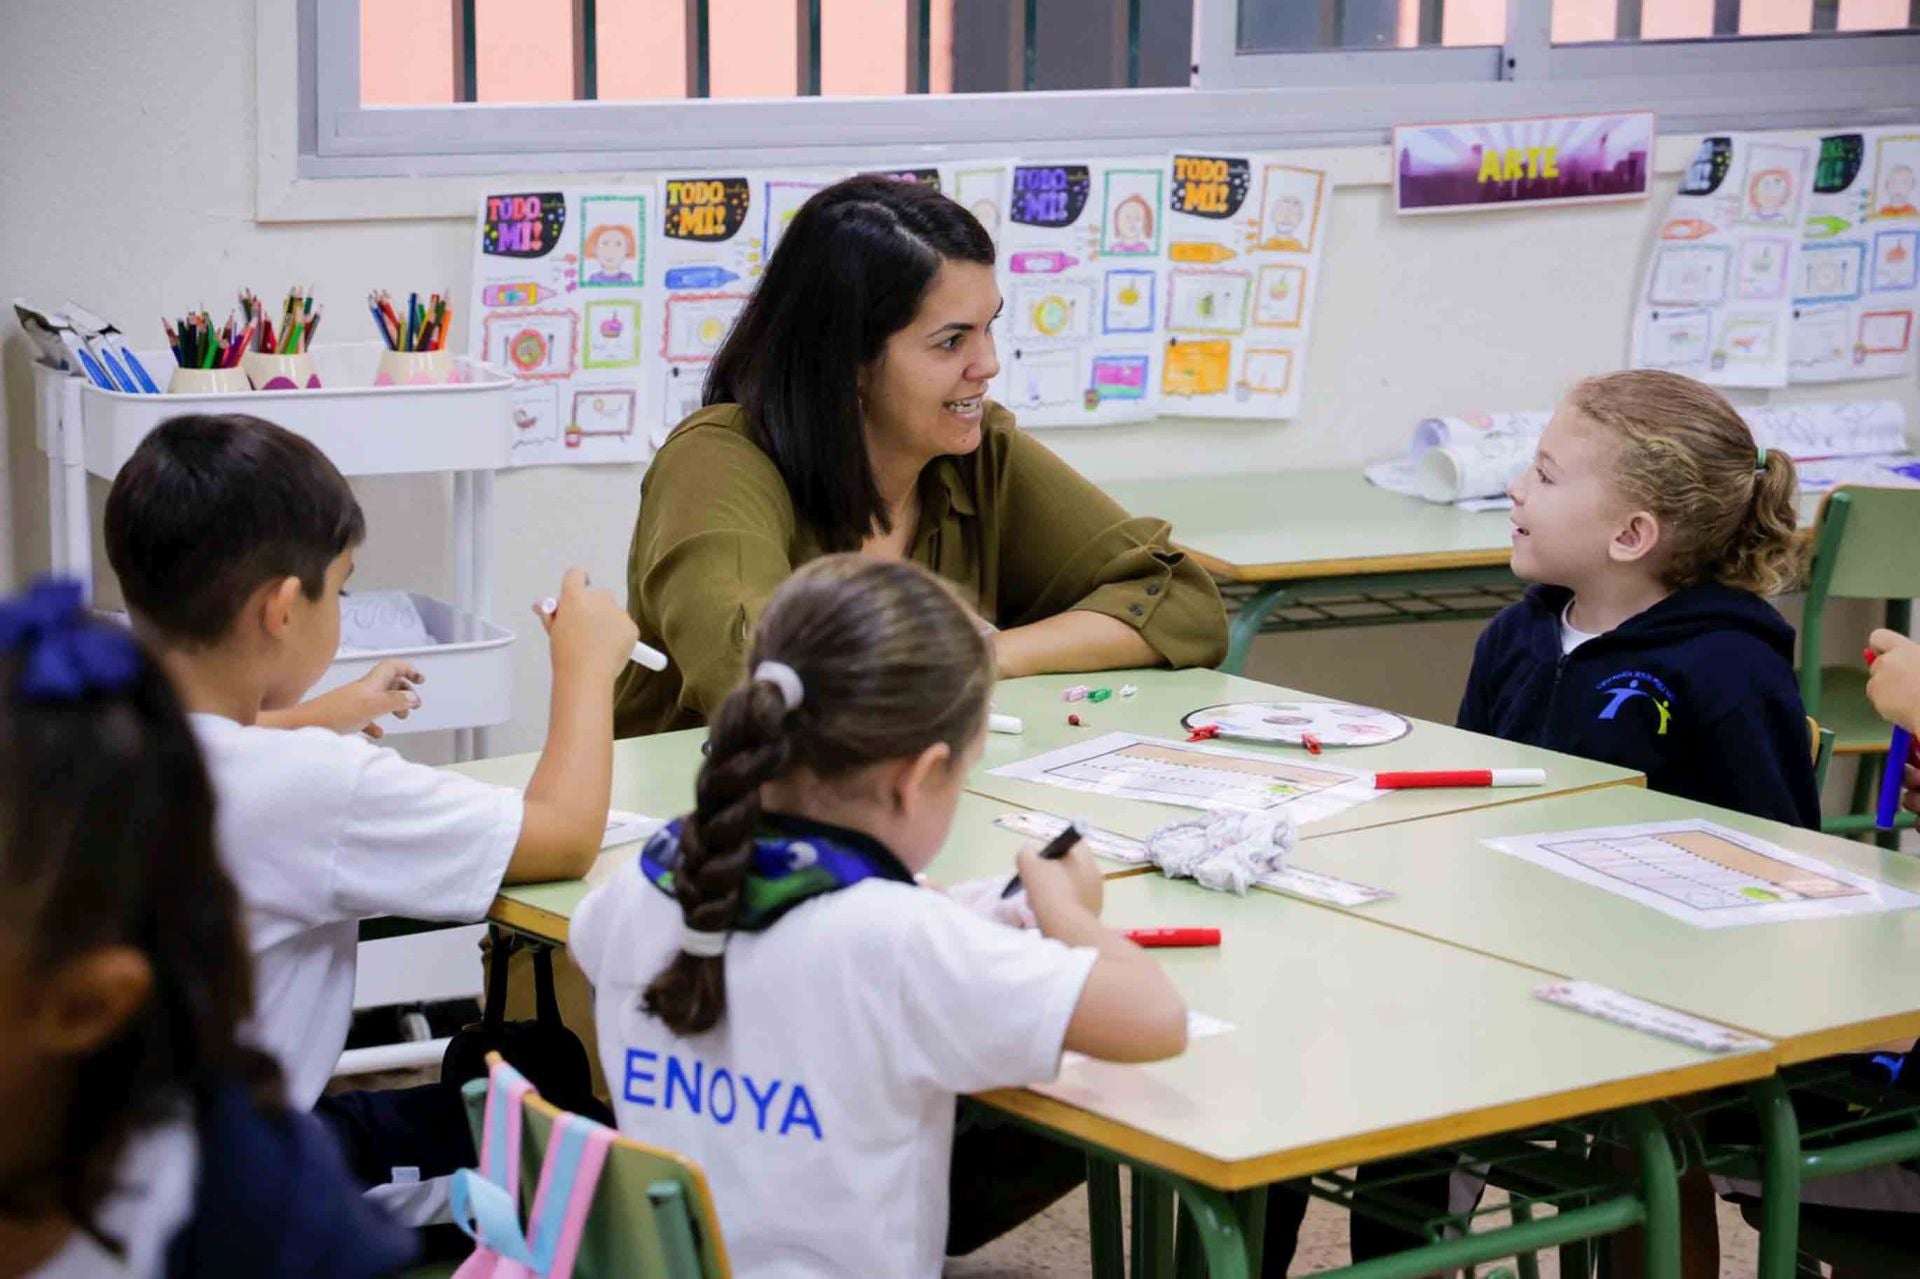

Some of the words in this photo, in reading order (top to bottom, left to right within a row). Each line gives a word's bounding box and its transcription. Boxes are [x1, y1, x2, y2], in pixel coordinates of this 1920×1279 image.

[1174, 158, 1228, 181] TODO
[1478, 148, 1559, 182] ARTE
[1016, 168, 1067, 190] TODO
[667, 181, 724, 205] TODO
[488, 196, 541, 221] TODO
[623, 1047, 823, 1140] ENOYA
